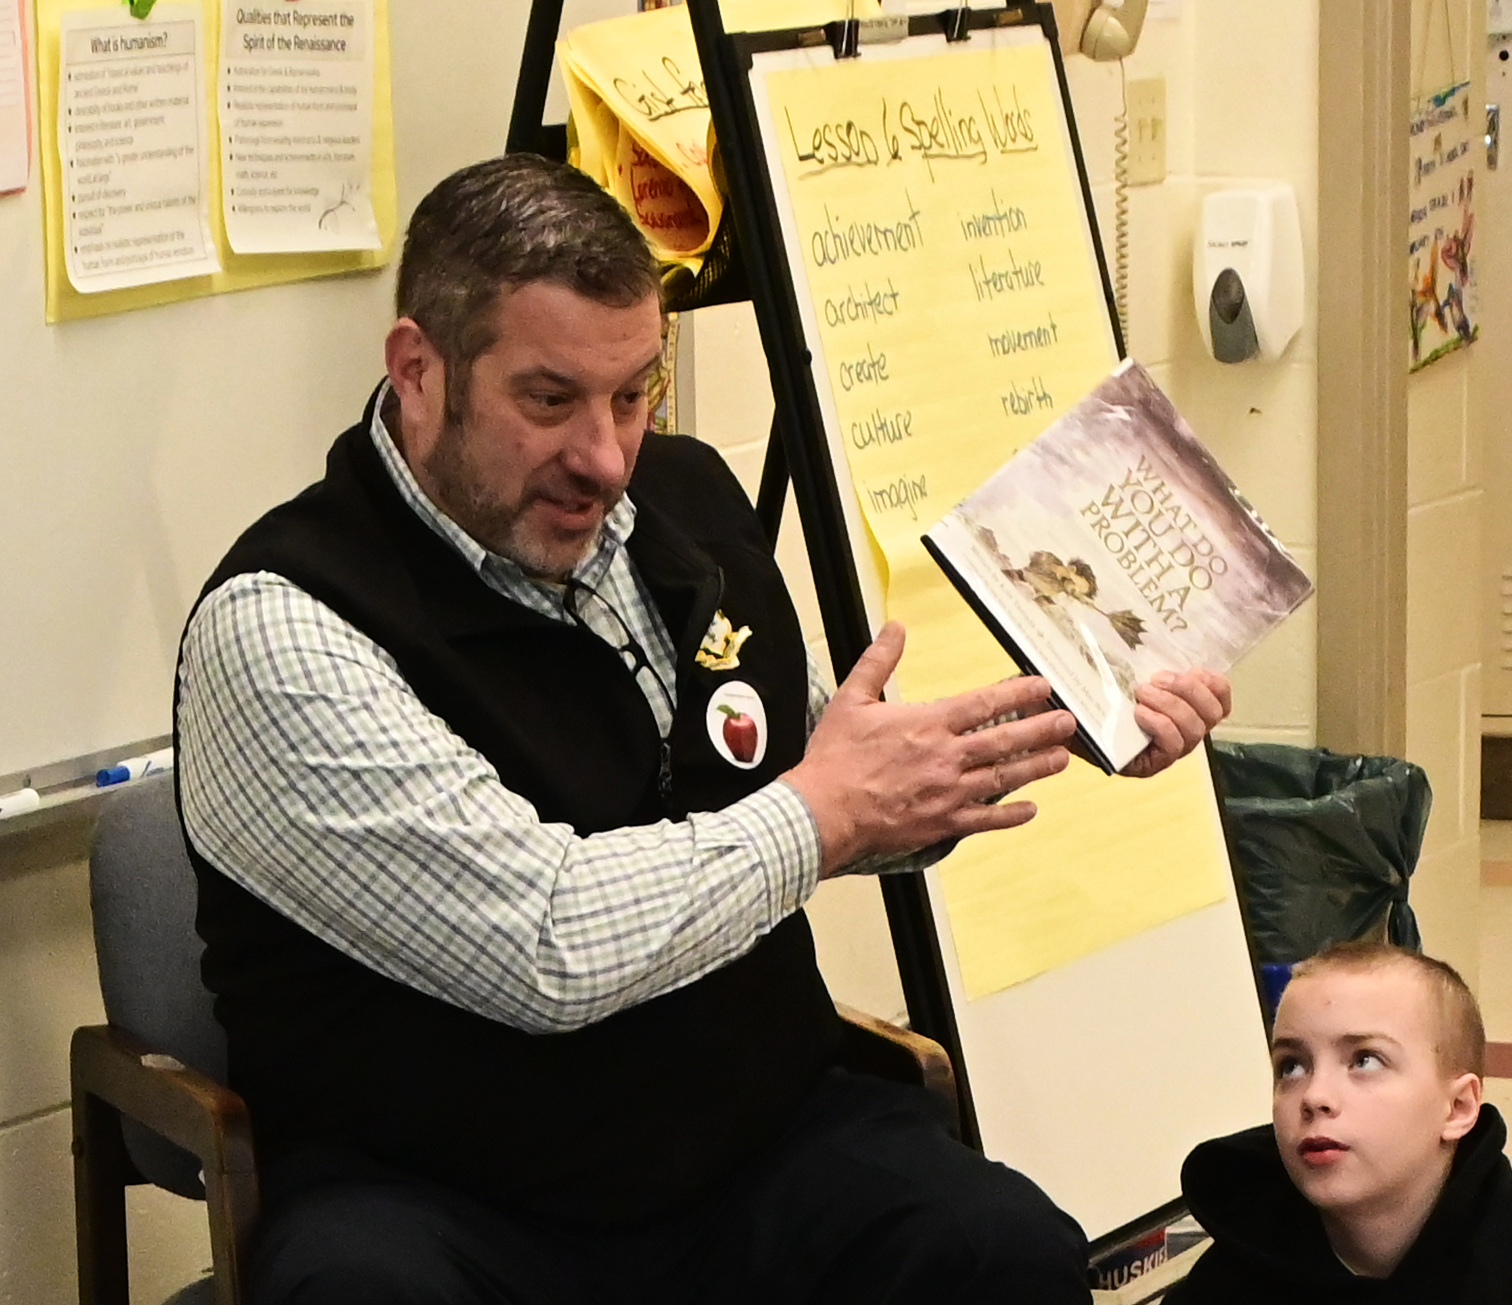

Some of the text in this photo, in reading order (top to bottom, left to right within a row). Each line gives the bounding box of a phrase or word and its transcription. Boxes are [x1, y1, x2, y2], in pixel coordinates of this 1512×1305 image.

[90, 32, 168, 54] What is humanism?
[237, 8, 355, 29] Qualities that Represent the
[243, 34, 346, 54] Spirit of the Renaissance
[785, 106, 879, 166] Lesson
[899, 86, 988, 183] Spelling
[978, 85, 1035, 150] Words
[811, 189, 1028, 267] achievement invention
[824, 249, 1046, 328] architect literature
[838, 311, 1058, 392] create movement
[851, 376, 1054, 450] culture rebirth
[866, 472, 929, 522] imagine
[1119, 466, 1214, 592] YOU DO
[1136, 453, 1229, 578] WHAT DO
[1079, 500, 1189, 634] PROBLEM?
[1100, 482, 1192, 613] WITH A
